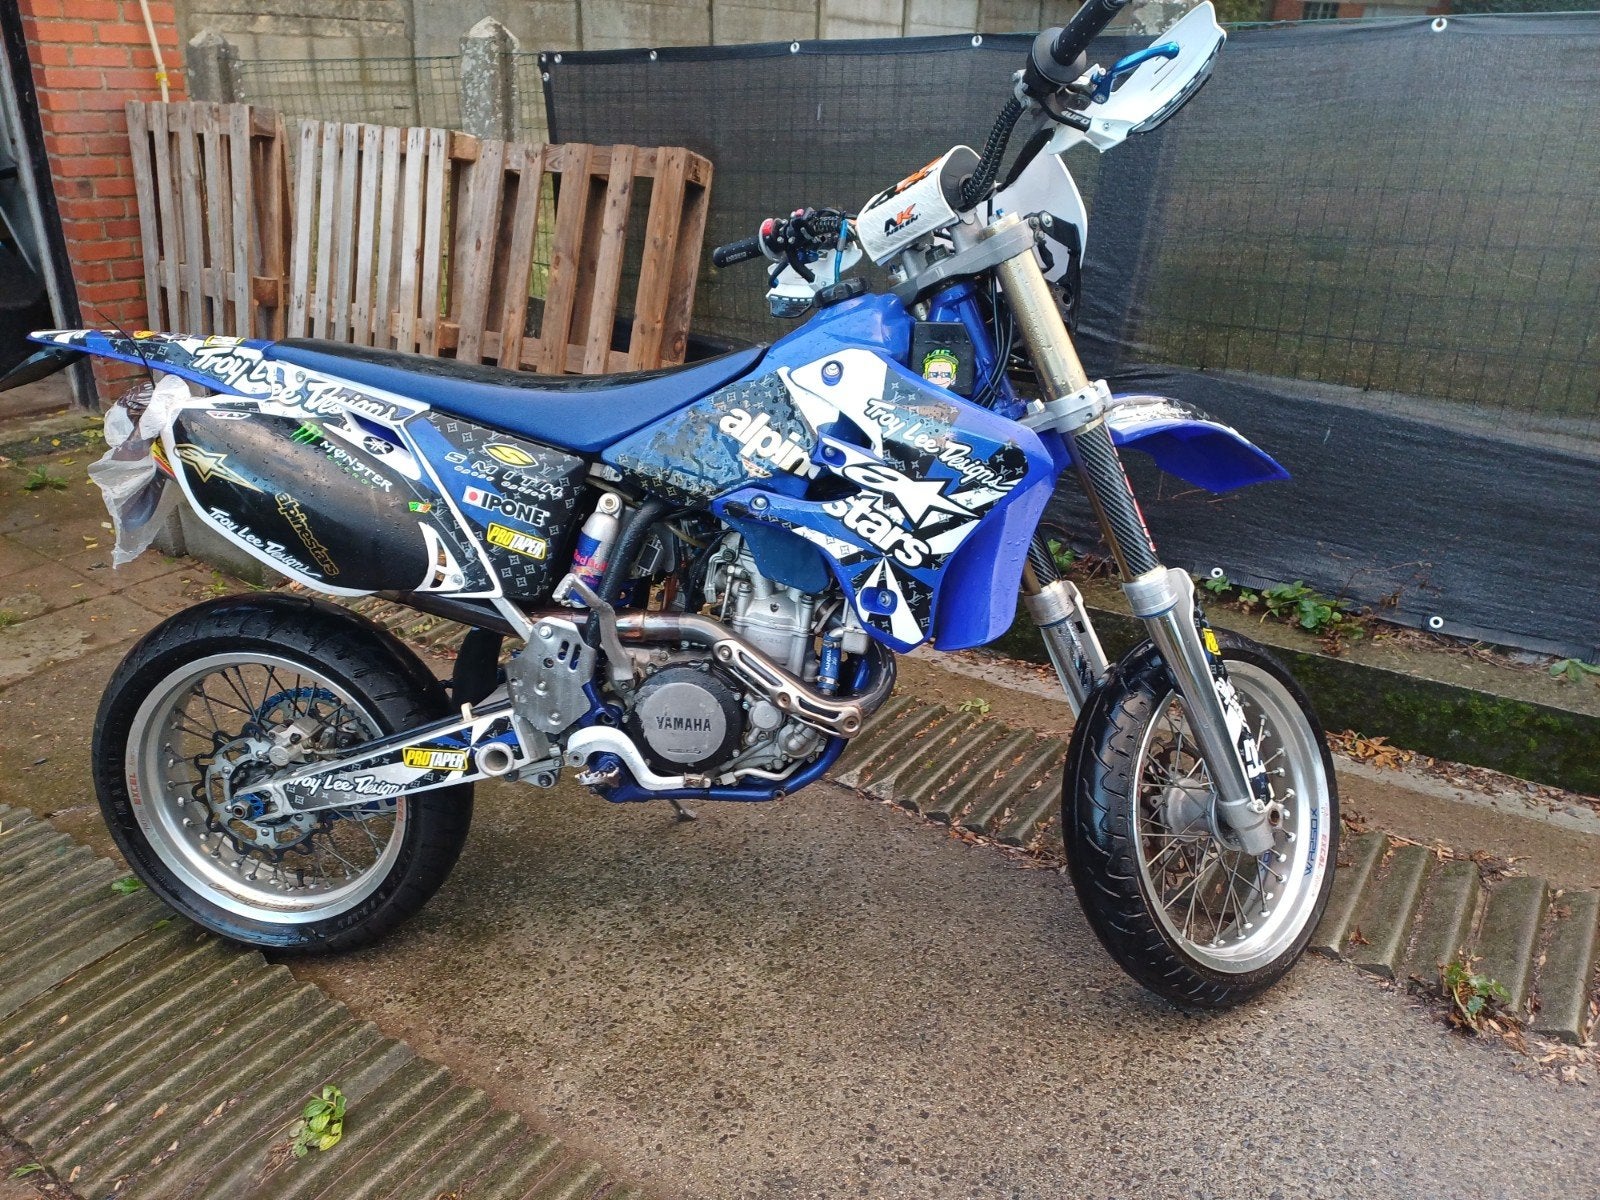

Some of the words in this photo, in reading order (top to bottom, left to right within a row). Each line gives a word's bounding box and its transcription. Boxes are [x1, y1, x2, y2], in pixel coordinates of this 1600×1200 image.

[194, 348, 248, 386] Troy
[867, 399, 906, 438] Troy
[903, 422, 940, 453] Lee
[937, 440, 1017, 491] Designs
[444, 451, 564, 498] SMITH
[481, 493, 546, 527] IPONE
[821, 489, 931, 568] stars
[210, 506, 239, 533] Troy
[240, 526, 264, 548] Lee
[265, 541, 322, 578] Designs
[656, 716, 711, 732] YAMAHA
[129, 772, 142, 806] EXCEL
[323, 774, 353, 792] Lee
[1303, 807, 1319, 877] WR250X
